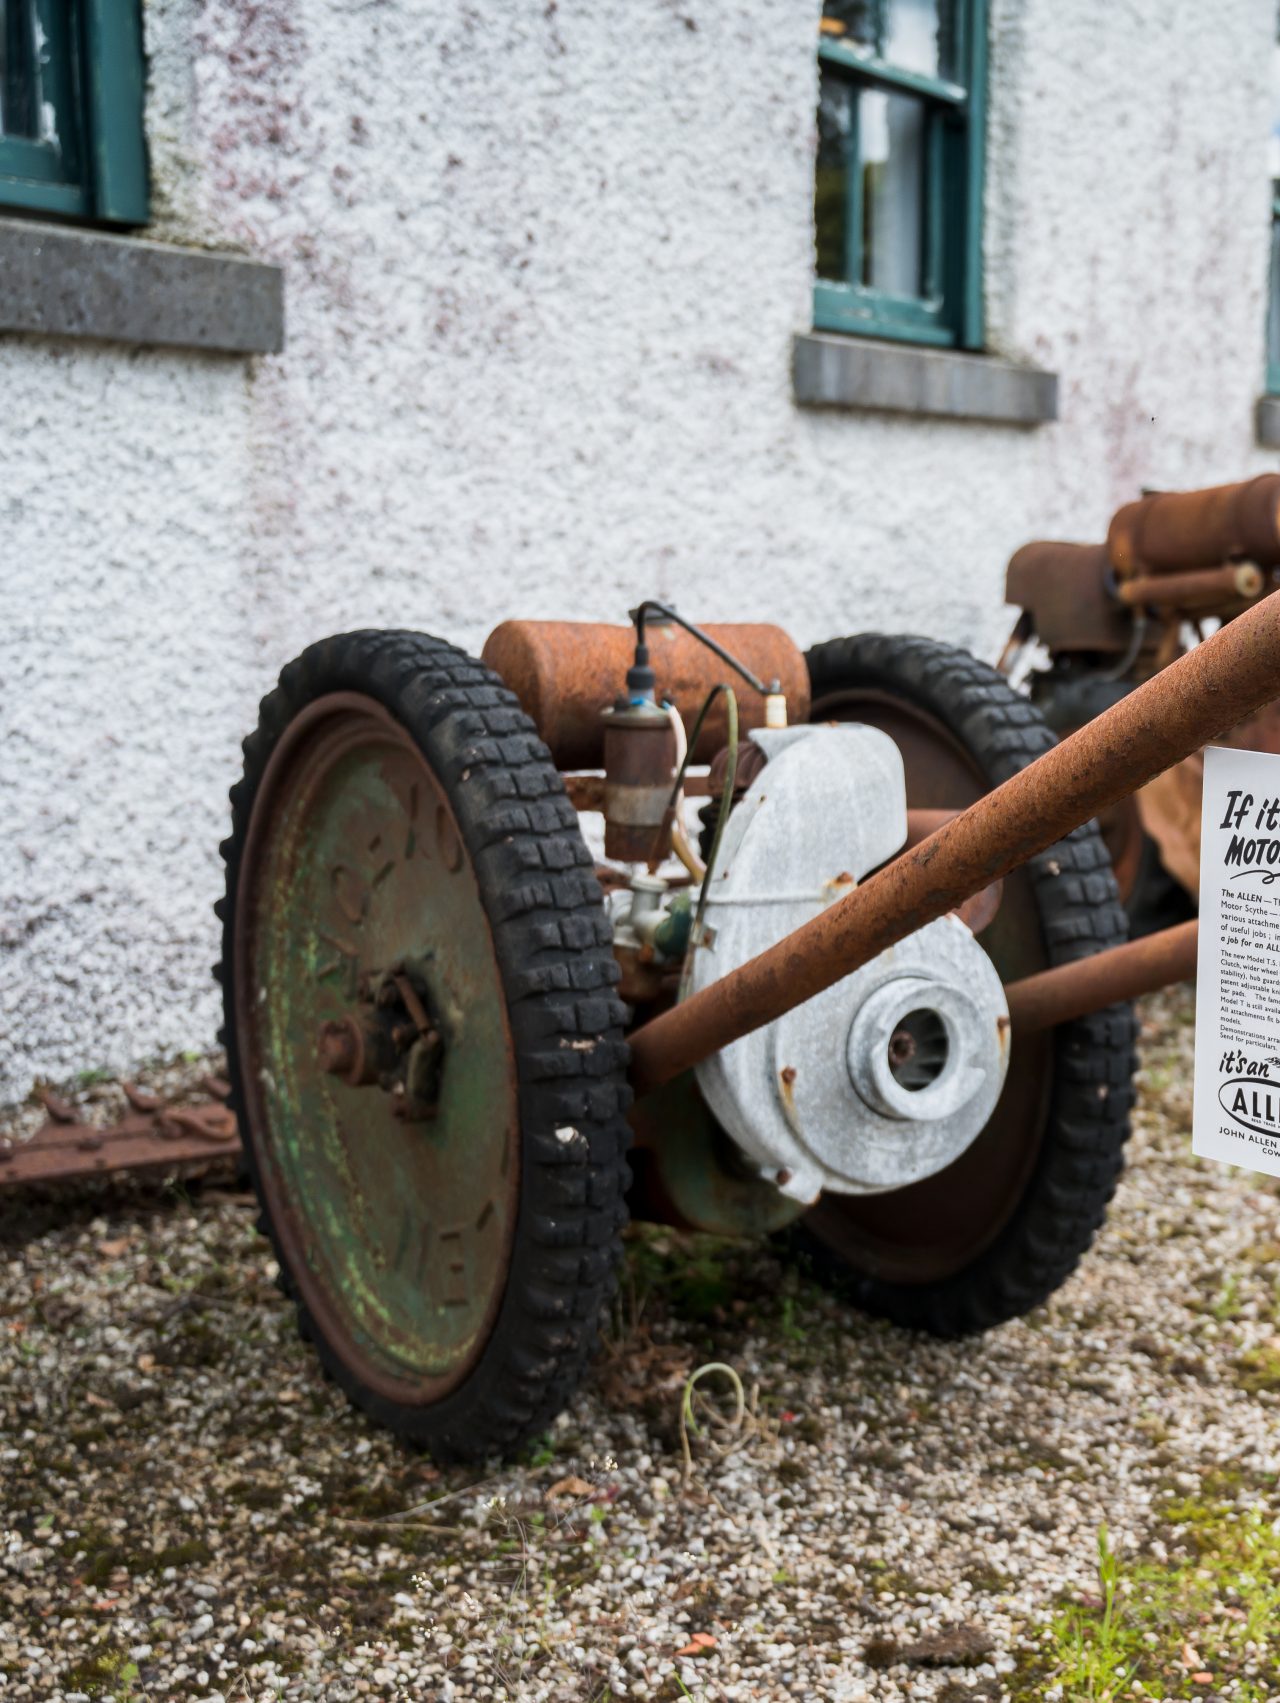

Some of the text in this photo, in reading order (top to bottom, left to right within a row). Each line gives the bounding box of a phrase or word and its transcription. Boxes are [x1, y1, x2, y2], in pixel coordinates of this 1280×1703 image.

[1220, 791, 1253, 829] If
[1221, 888, 1235, 899] The
[1236, 892, 1263, 904] ALLEN
[1221, 900, 1243, 911] Motor
[1245, 904, 1268, 916] Scythe
[1221, 913, 1246, 923] various
[1230, 926, 1250, 935] useful
[1226, 936, 1239, 945] job
[1241, 938, 1252, 947] for
[1221, 949, 1232, 958] The
[1246, 954, 1265, 964] Model
[1266, 958, 1278, 967] T.S.
[1220, 958, 1242, 970] Clutch,
[1242, 964, 1260, 972] wider
[1260, 968, 1279, 976] wheel
[1220, 969, 1248, 980] stability),
[1249, 974, 1261, 982] hub
[1220, 978, 1239, 987] patent
[1241, 982, 1270, 994] adjustable
[1220, 996, 1238, 1005] Model
[1254, 993, 1267, 1002] The
[1220, 1016, 1242, 1026] models.
[1230, 1009, 1266, 1021] attachments
[1220, 1024, 1266, 1043] Demonstrations
[1220, 1032, 1234, 1041] Send
[1245, 1039, 1280, 1051] particulars.
[1219, 1050, 1269, 1078] it's an
[1219, 1127, 1245, 1140] JOHN
[1248, 1135, 1277, 1148] ALLEN
